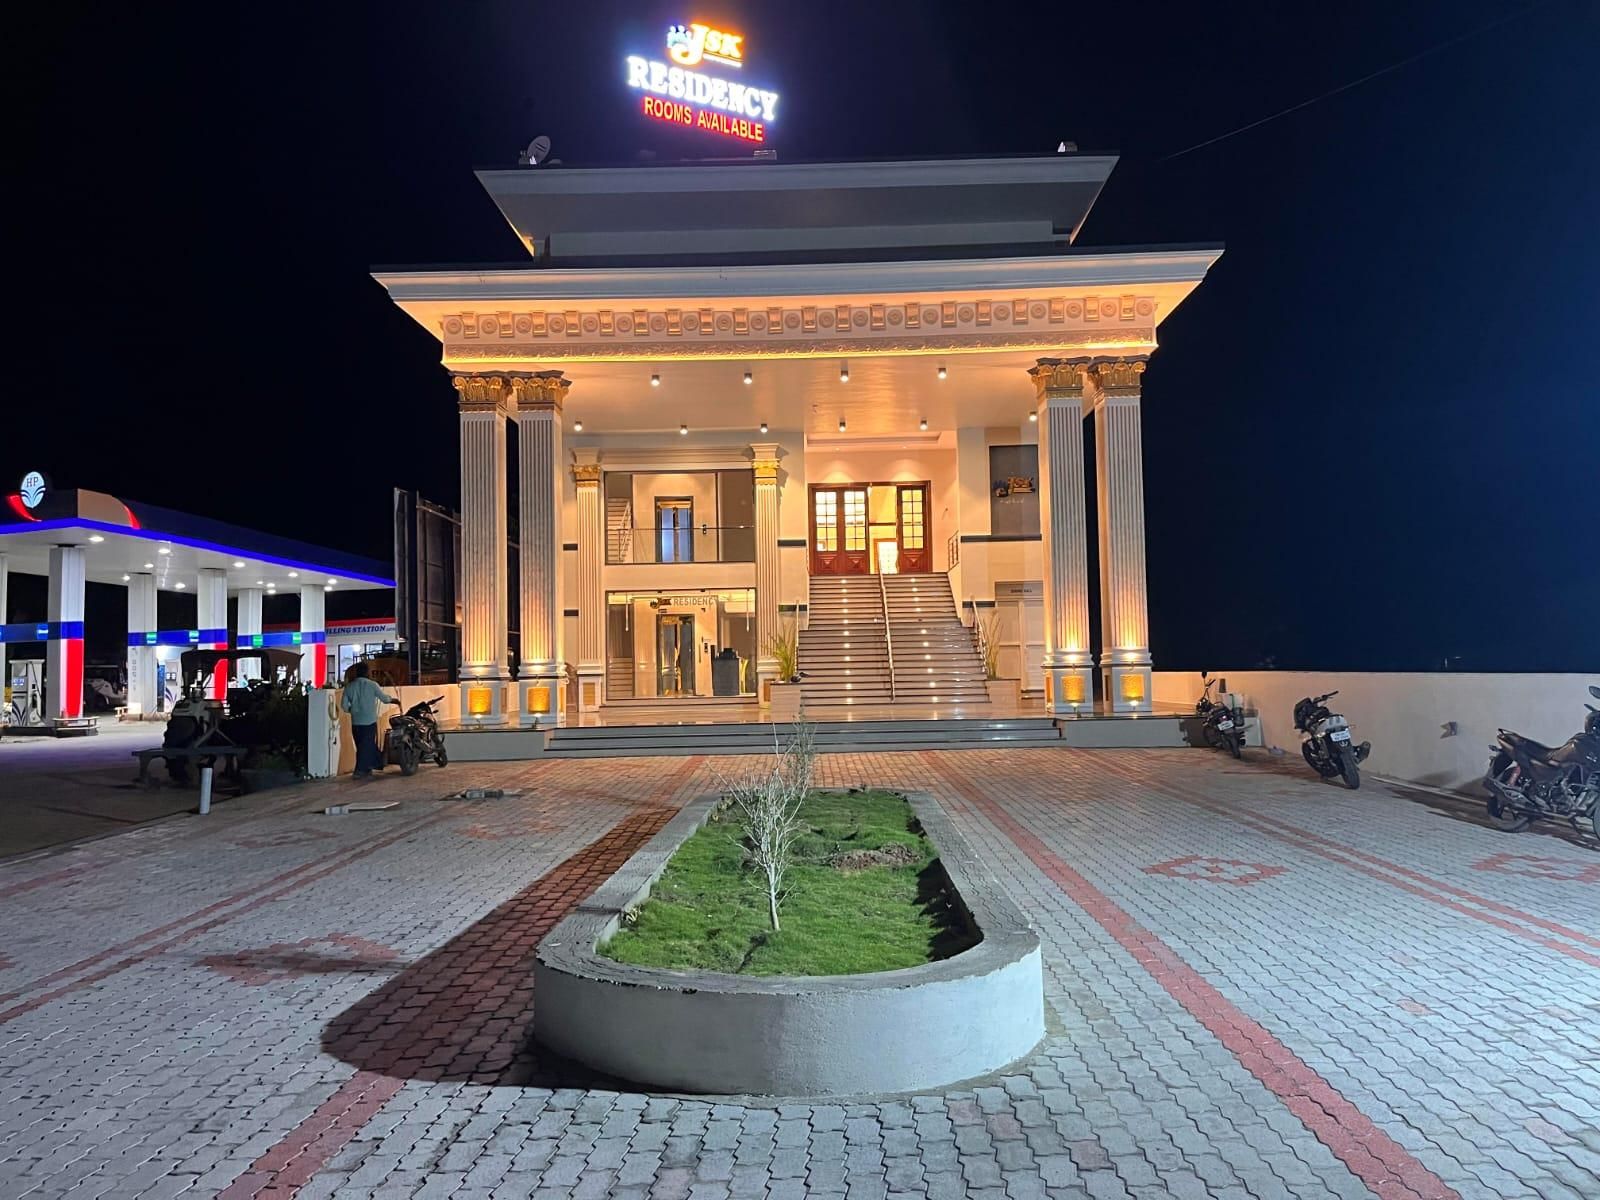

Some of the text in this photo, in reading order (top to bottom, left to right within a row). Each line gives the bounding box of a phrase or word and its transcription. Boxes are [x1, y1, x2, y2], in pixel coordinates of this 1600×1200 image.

[669, 23, 744, 65] JSK
[626, 55, 778, 121] RESIDENCY
[644, 96, 764, 142] ROOMS AVAILABLE
[26, 476, 39, 488] HP
[326, 627, 351, 635] ILLING
[352, 625, 386, 633] STATION
